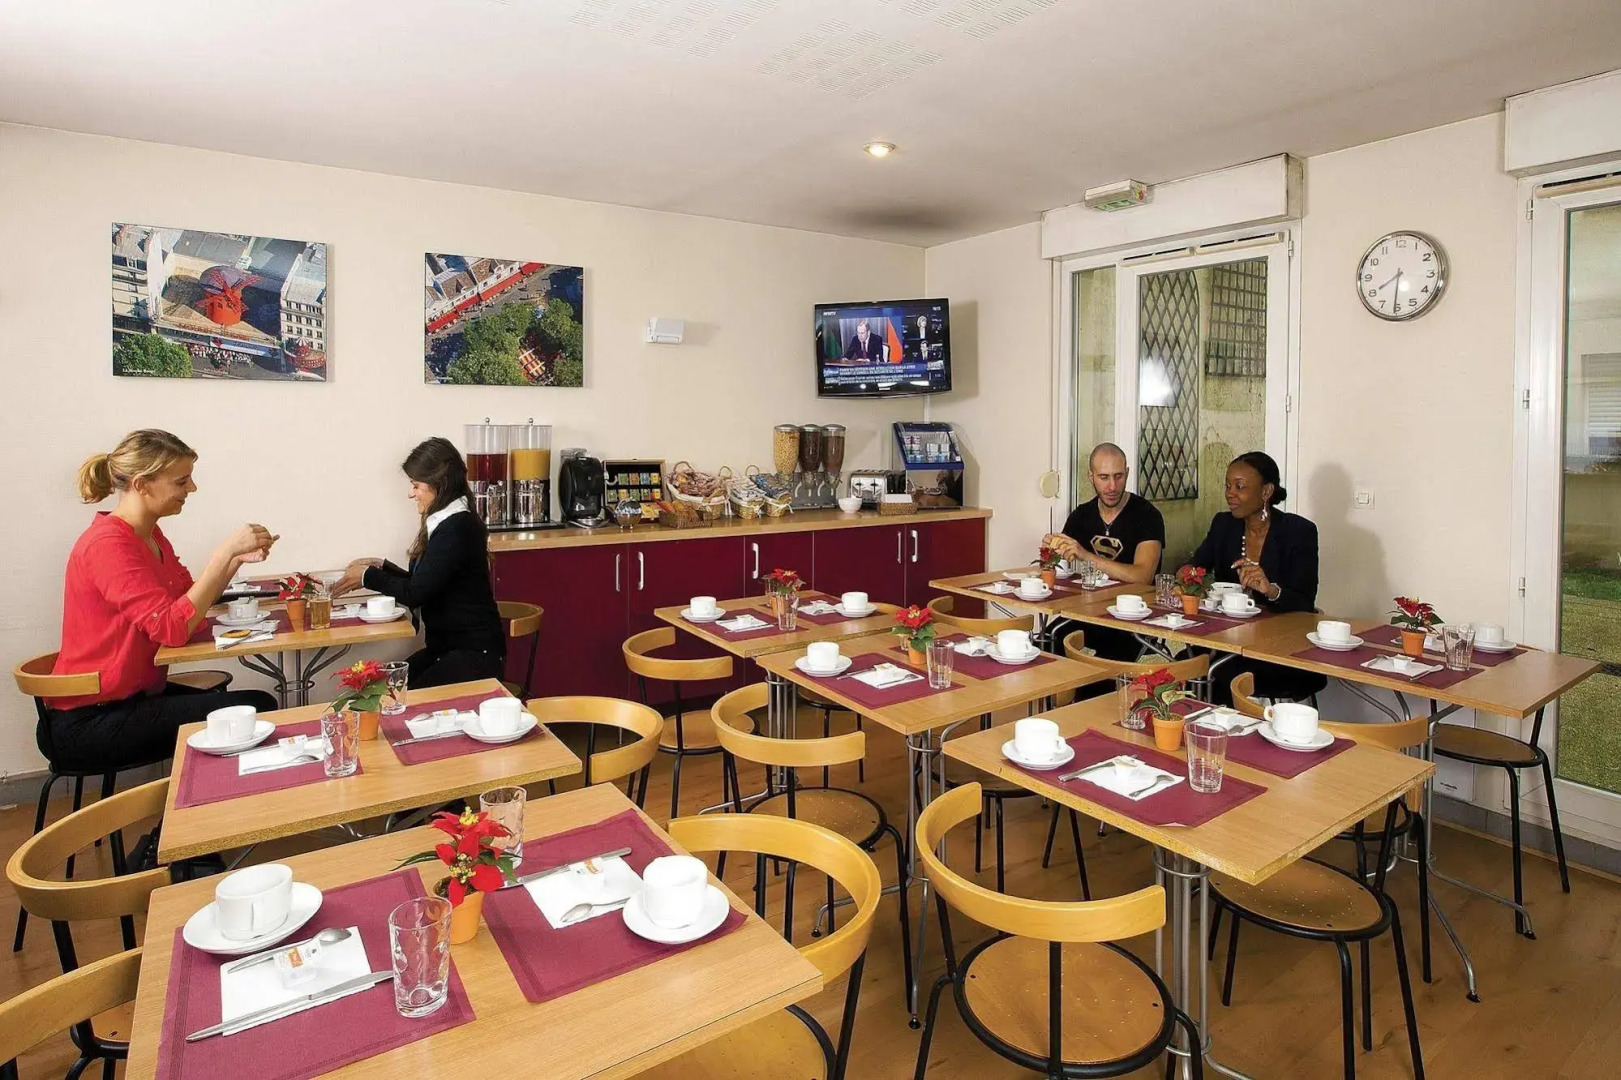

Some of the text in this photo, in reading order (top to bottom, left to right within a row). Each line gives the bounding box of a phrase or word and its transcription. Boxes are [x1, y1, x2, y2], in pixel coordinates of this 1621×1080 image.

[1395, 240, 1407, 248] 12
[1381, 246, 1388, 255] 11
[1422, 252, 1432, 262] 2
[1370, 258, 1379, 266] 10
[1364, 273, 1373, 282] 9
[1426, 269, 1435, 278] 3
[1368, 289, 1377, 297] 8
[1420, 285, 1429, 294] 4
[1378, 300, 1386, 309] 7
[1408, 298, 1418, 307] 5
[1393, 303, 1402, 312] 6
